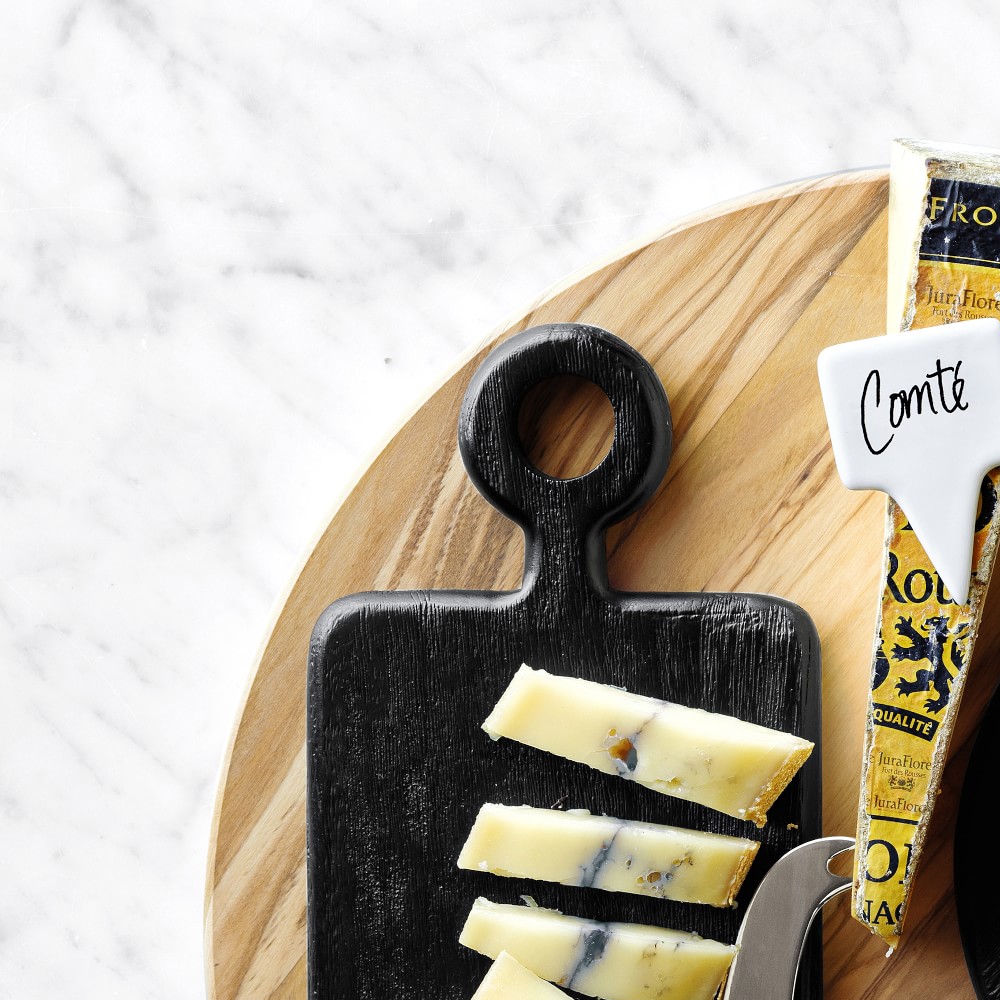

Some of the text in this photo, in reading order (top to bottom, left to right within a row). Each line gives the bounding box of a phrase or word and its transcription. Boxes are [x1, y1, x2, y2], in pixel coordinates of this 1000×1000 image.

[860, 359, 969, 455] Comté
[873, 707, 933, 737] QUALITÉ
[878, 751, 932, 771] JuraFlore
